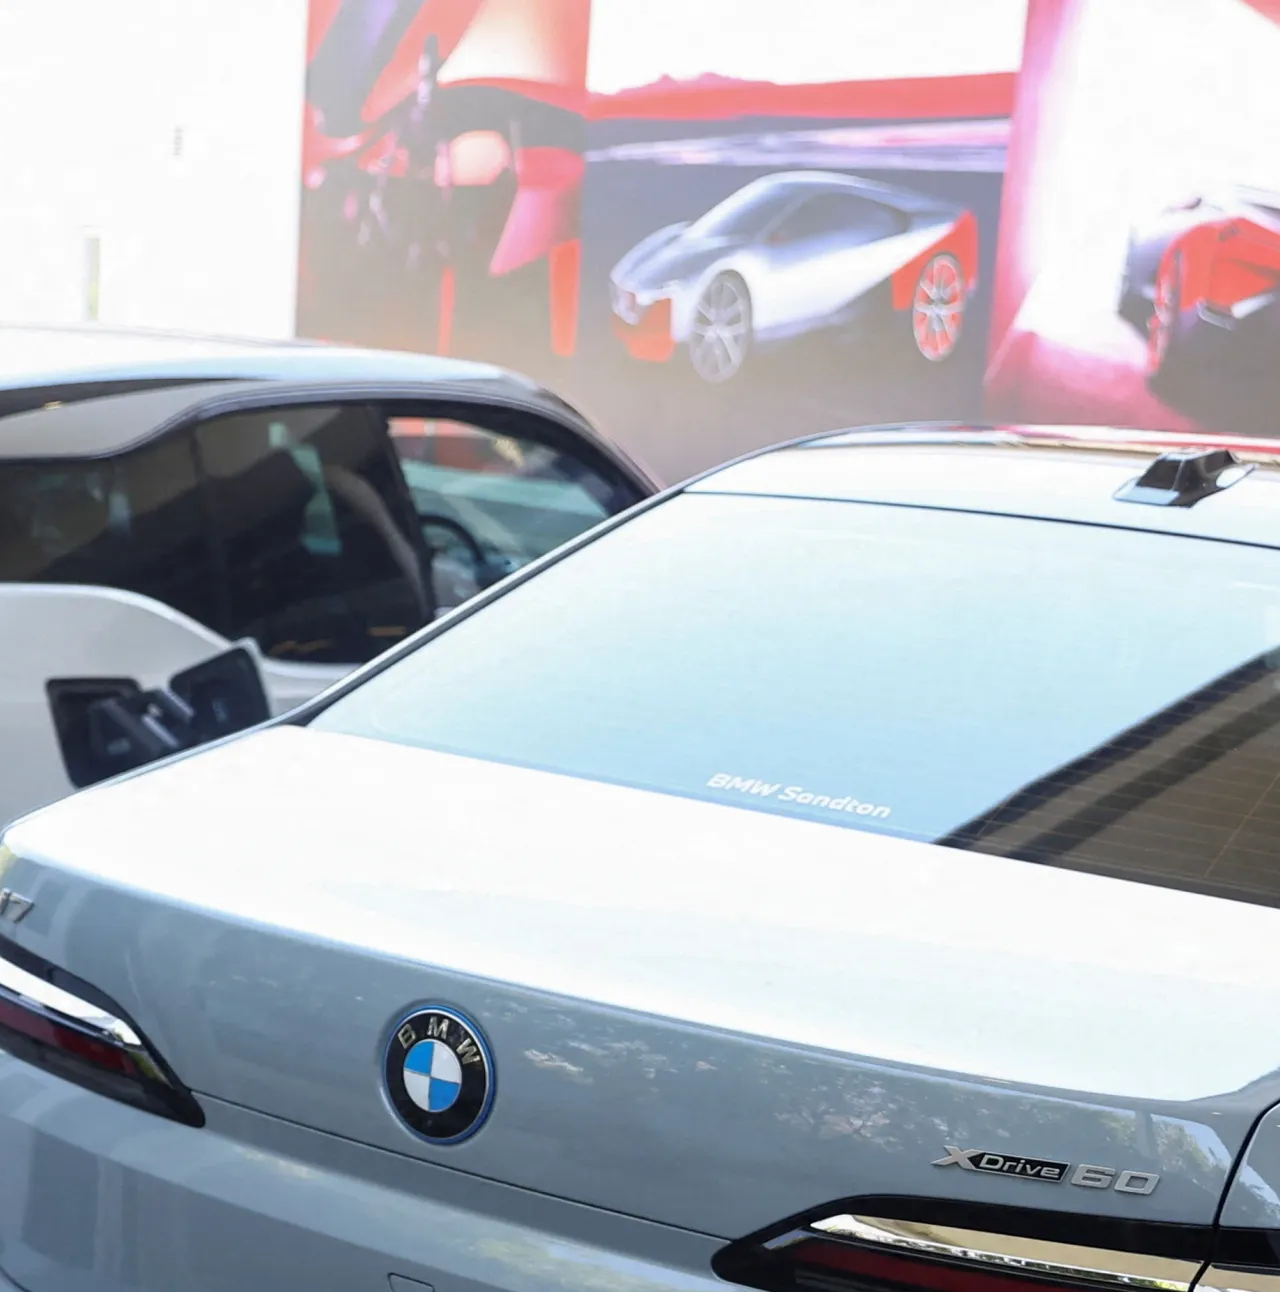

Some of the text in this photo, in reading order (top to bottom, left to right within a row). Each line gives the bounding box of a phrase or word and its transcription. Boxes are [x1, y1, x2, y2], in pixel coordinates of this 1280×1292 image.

[706, 772, 892, 818] BMW Sandton
[398, 1016, 481, 1065] BMW
[1071, 1163, 1161, 1195] 60
